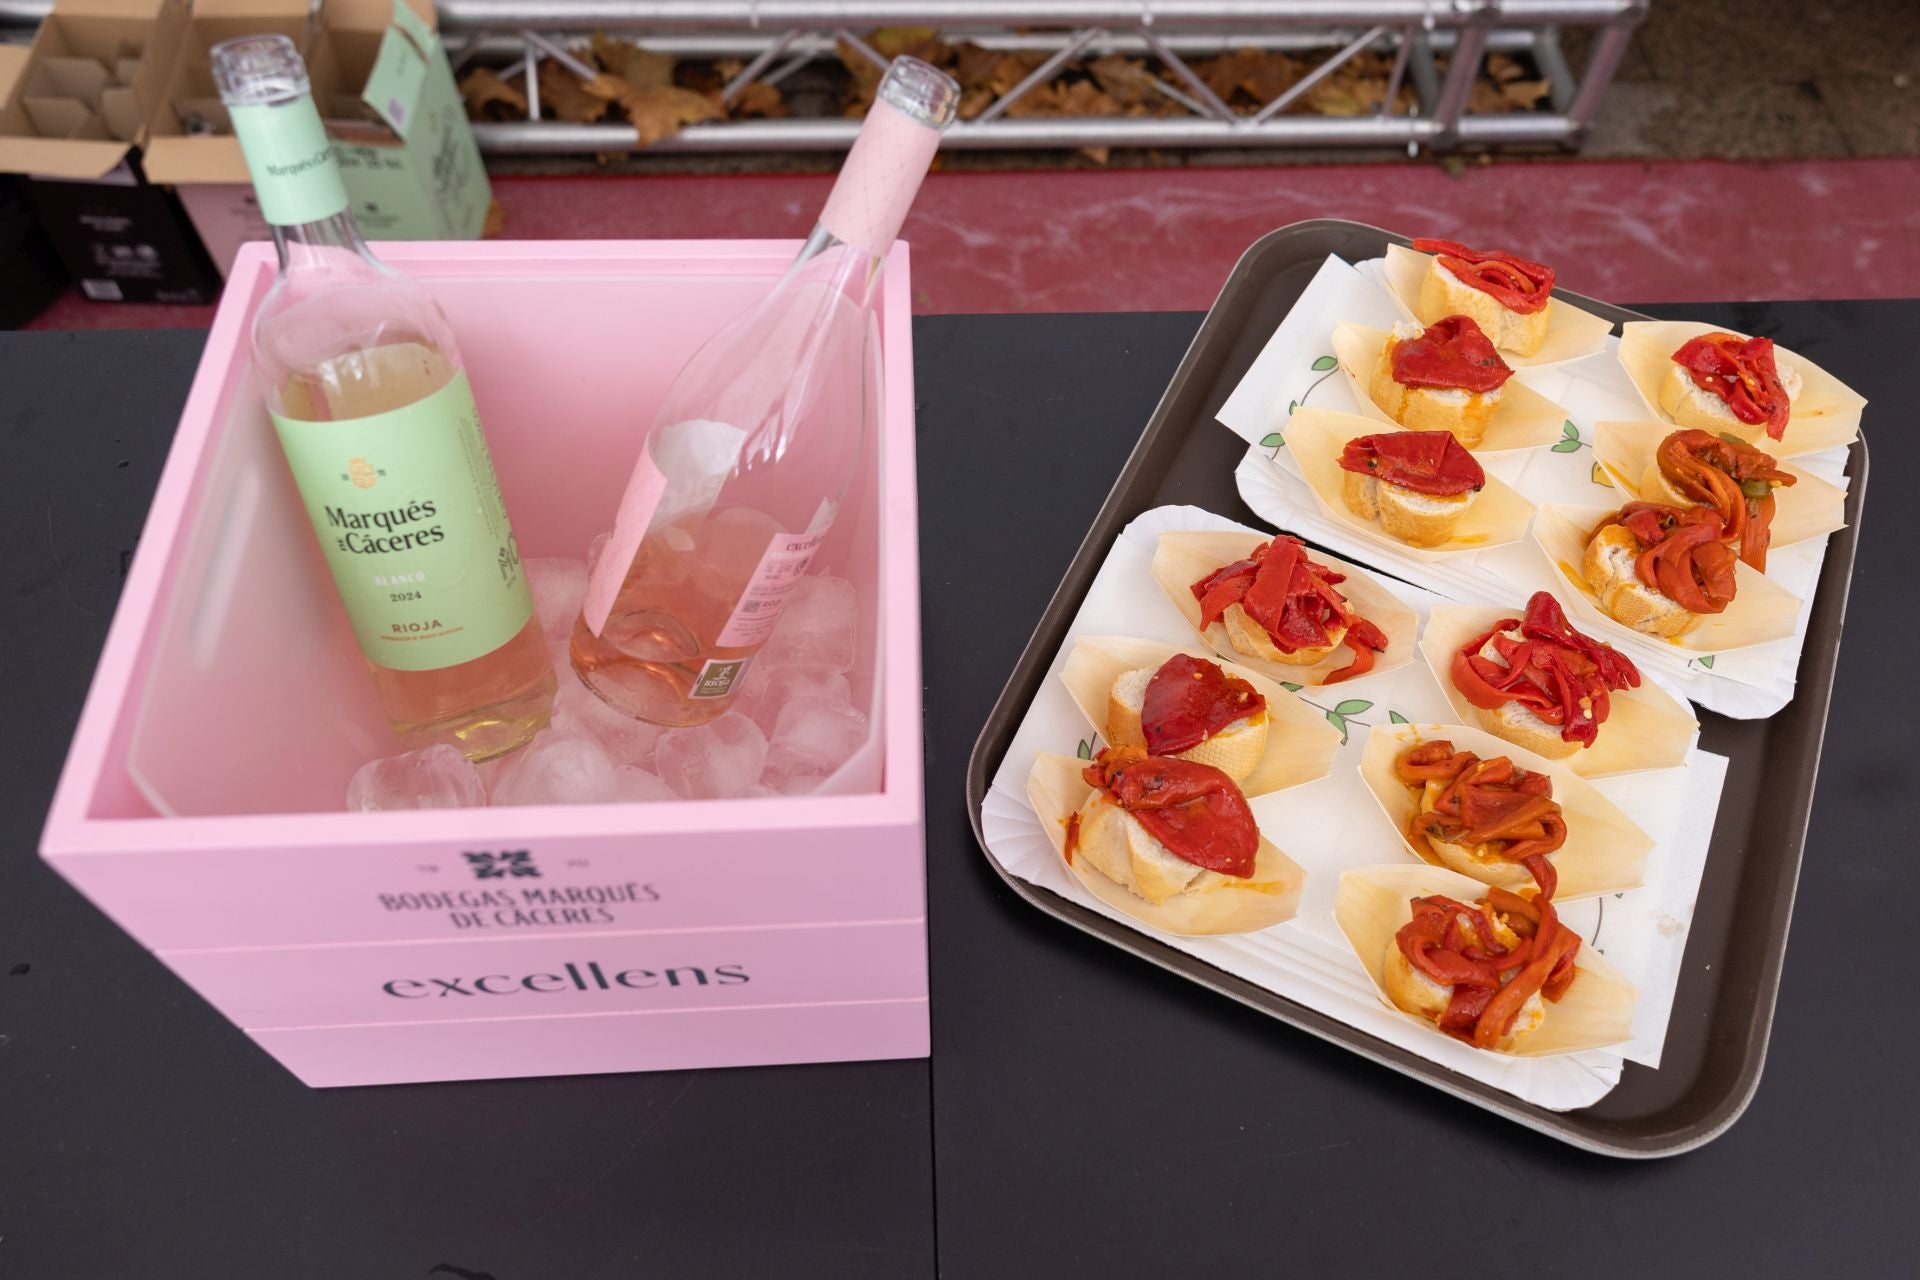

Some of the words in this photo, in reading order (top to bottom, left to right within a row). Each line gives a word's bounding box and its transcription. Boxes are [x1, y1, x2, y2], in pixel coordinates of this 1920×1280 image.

[324, 500, 437, 533] Marqués
[345, 525, 445, 554] Cáceres
[390, 591, 422, 602] 2024
[391, 619, 443, 633] RIOJA
[378, 889, 516, 911] BODEGAS
[449, 909, 490, 929] DE
[382, 961, 751, 999] excellens
